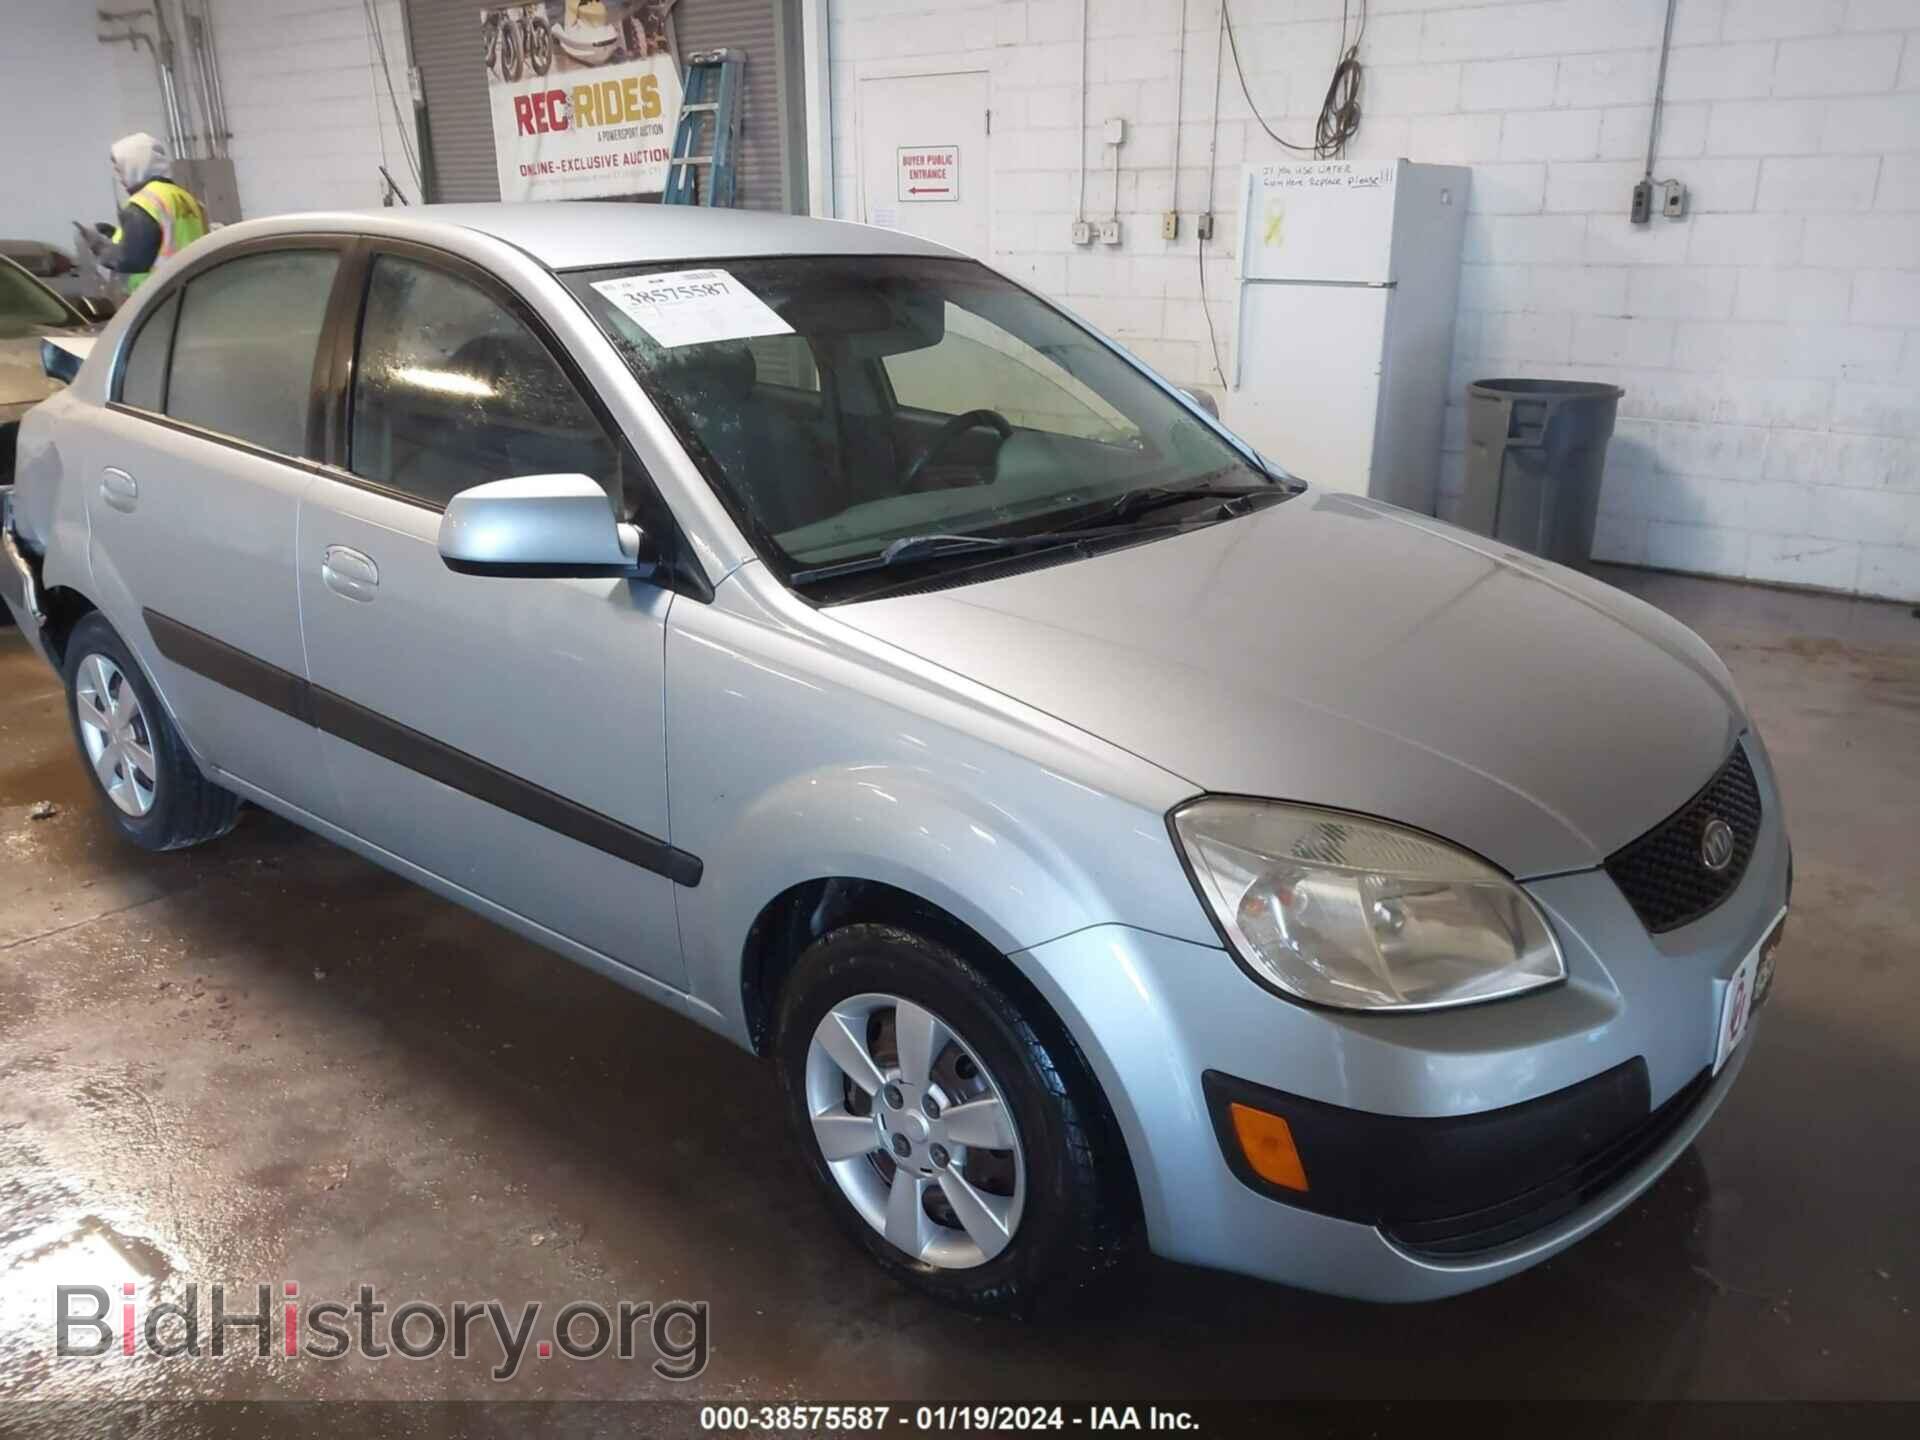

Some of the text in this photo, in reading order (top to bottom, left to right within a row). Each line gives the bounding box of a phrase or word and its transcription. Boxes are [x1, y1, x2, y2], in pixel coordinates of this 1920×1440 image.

[514, 90, 569, 136] REC
[572, 74, 662, 128] RIDES
[603, 127, 638, 141] POWERSPORT
[639, 124, 664, 137] AUCTION
[520, 154, 619, 177] ONLINE-EXCLUSIVE
[623, 148, 669, 166] AUCTION
[902, 154, 953, 167] BUYER PUBLIC
[909, 168, 947, 180] ENTRANCE
[624, 282, 730, 306] 38575587
